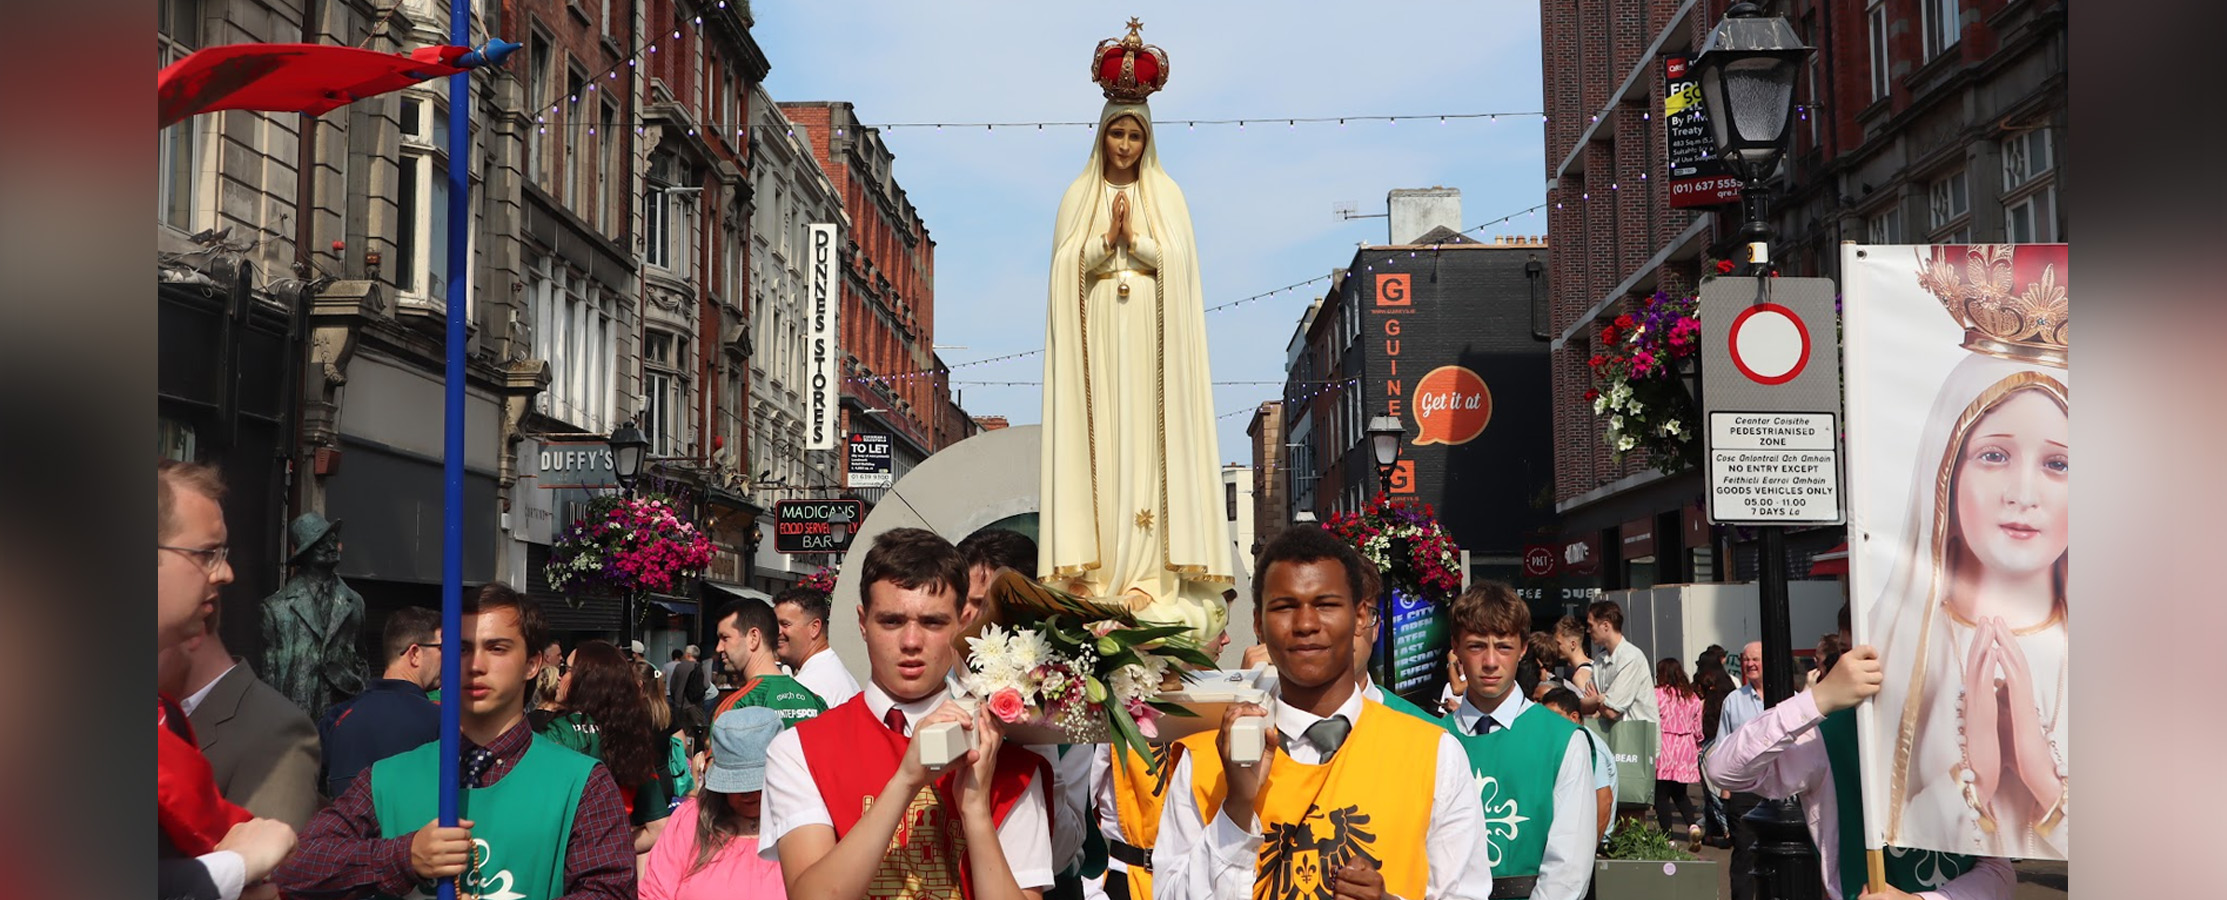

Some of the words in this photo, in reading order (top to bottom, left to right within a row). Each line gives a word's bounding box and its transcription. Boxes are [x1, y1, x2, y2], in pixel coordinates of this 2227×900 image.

[1672, 116, 1684, 127] By
[1687, 113, 1709, 123] Priv
[1672, 126, 1703, 137] Treaty
[1673, 183, 1692, 195] (01)
[1695, 181, 1714, 191] 637
[1717, 188, 1737, 198] qre.i
[815, 230, 829, 331] DUNNES
[1382, 278, 1404, 301] G
[812, 339, 826, 444] STORES
[1385, 319, 1402, 456] GUINE
[1421, 392, 1448, 418] Get
[1449, 391, 1462, 409] it
[1465, 393, 1481, 410] at
[1735, 416, 1770, 425] Ceantar
[1773, 416, 1810, 426] Coisithe
[1730, 427, 1815, 435] PEDESTRIANISED
[850, 443, 867, 453] TO
[869, 443, 889, 454] LET
[1760, 438, 1786, 446] ZONE
[541, 450, 613, 471] DUFFY'S
[1716, 454, 1736, 462] Cosc
[1716, 486, 1752, 494] GOODS
[782, 505, 855, 519] MADIGANS
[780, 522, 803, 534] FOOD
[804, 522, 830, 535] SERVE
[803, 535, 833, 548] BAR
